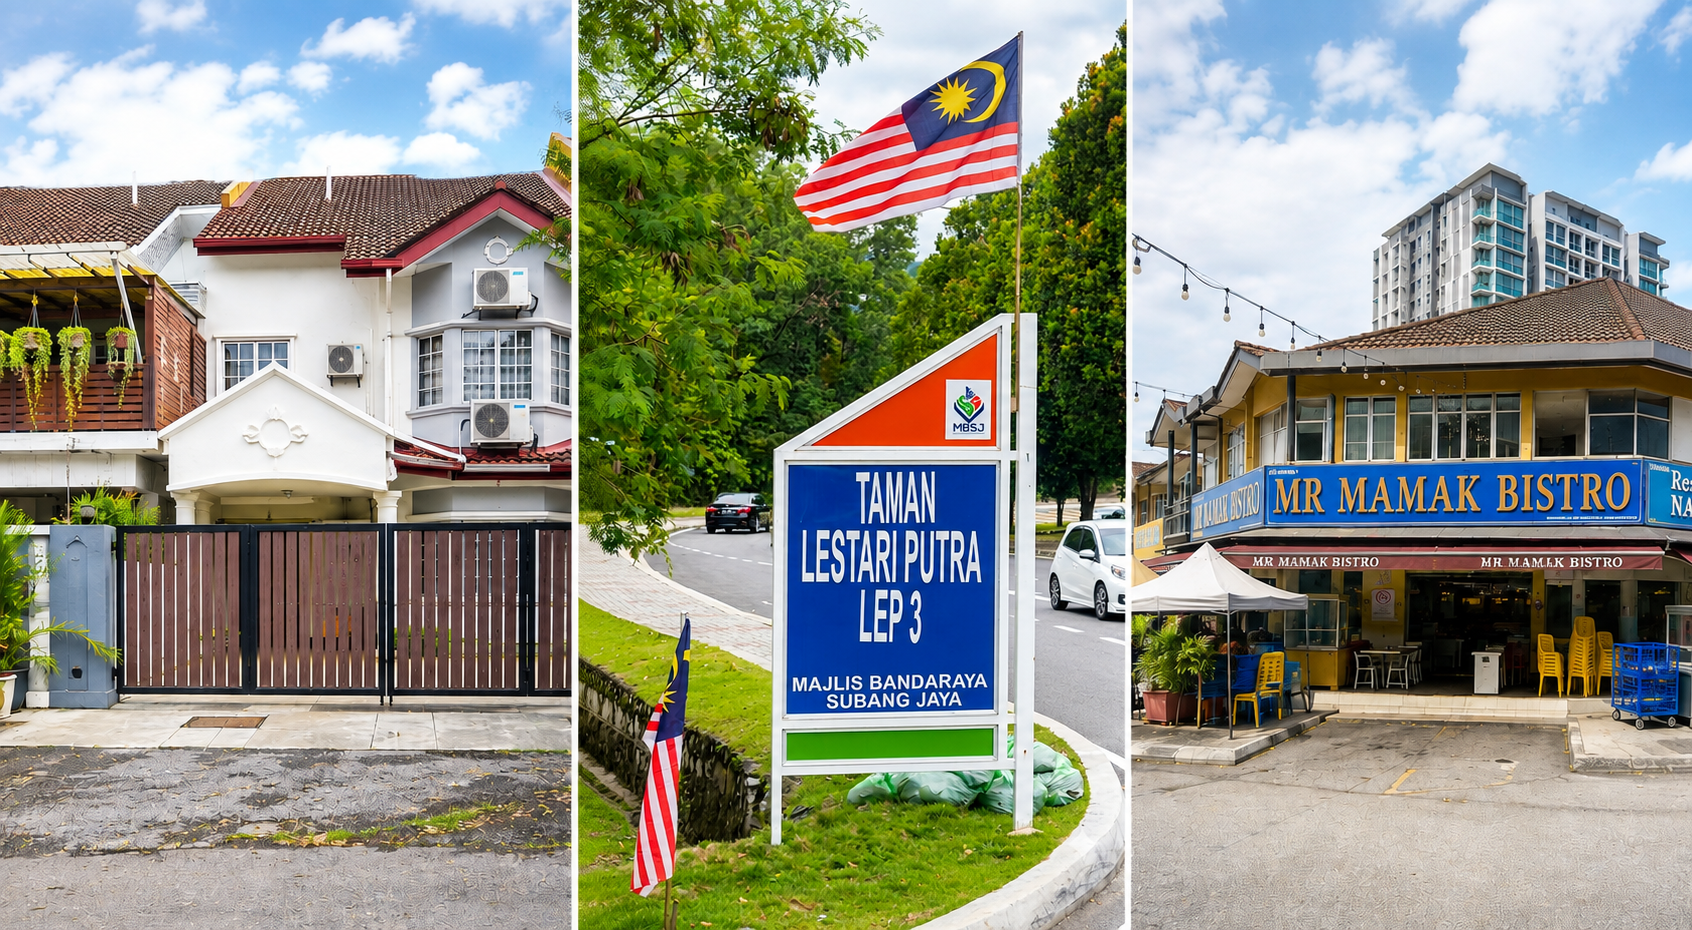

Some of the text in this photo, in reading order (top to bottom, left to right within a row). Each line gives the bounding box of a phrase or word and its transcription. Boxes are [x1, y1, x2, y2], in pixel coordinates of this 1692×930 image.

[953, 423, 985, 432] MBSJ
[855, 471, 936, 525] TAMAN
[1273, 472, 1631, 514] MR MAMAK BISTRO
[801, 529, 982, 584] LESTARI PUTRA
[1252, 556, 1379, 567] MR MAMAK BISTRO
[1480, 556, 1503, 568] MR
[1569, 556, 1623, 568] BISTRO
[859, 589, 922, 644] LEP 3
[792, 673, 988, 692] MAJLIS BANDARAYA
[826, 691, 963, 709] SUBANG JAYA
